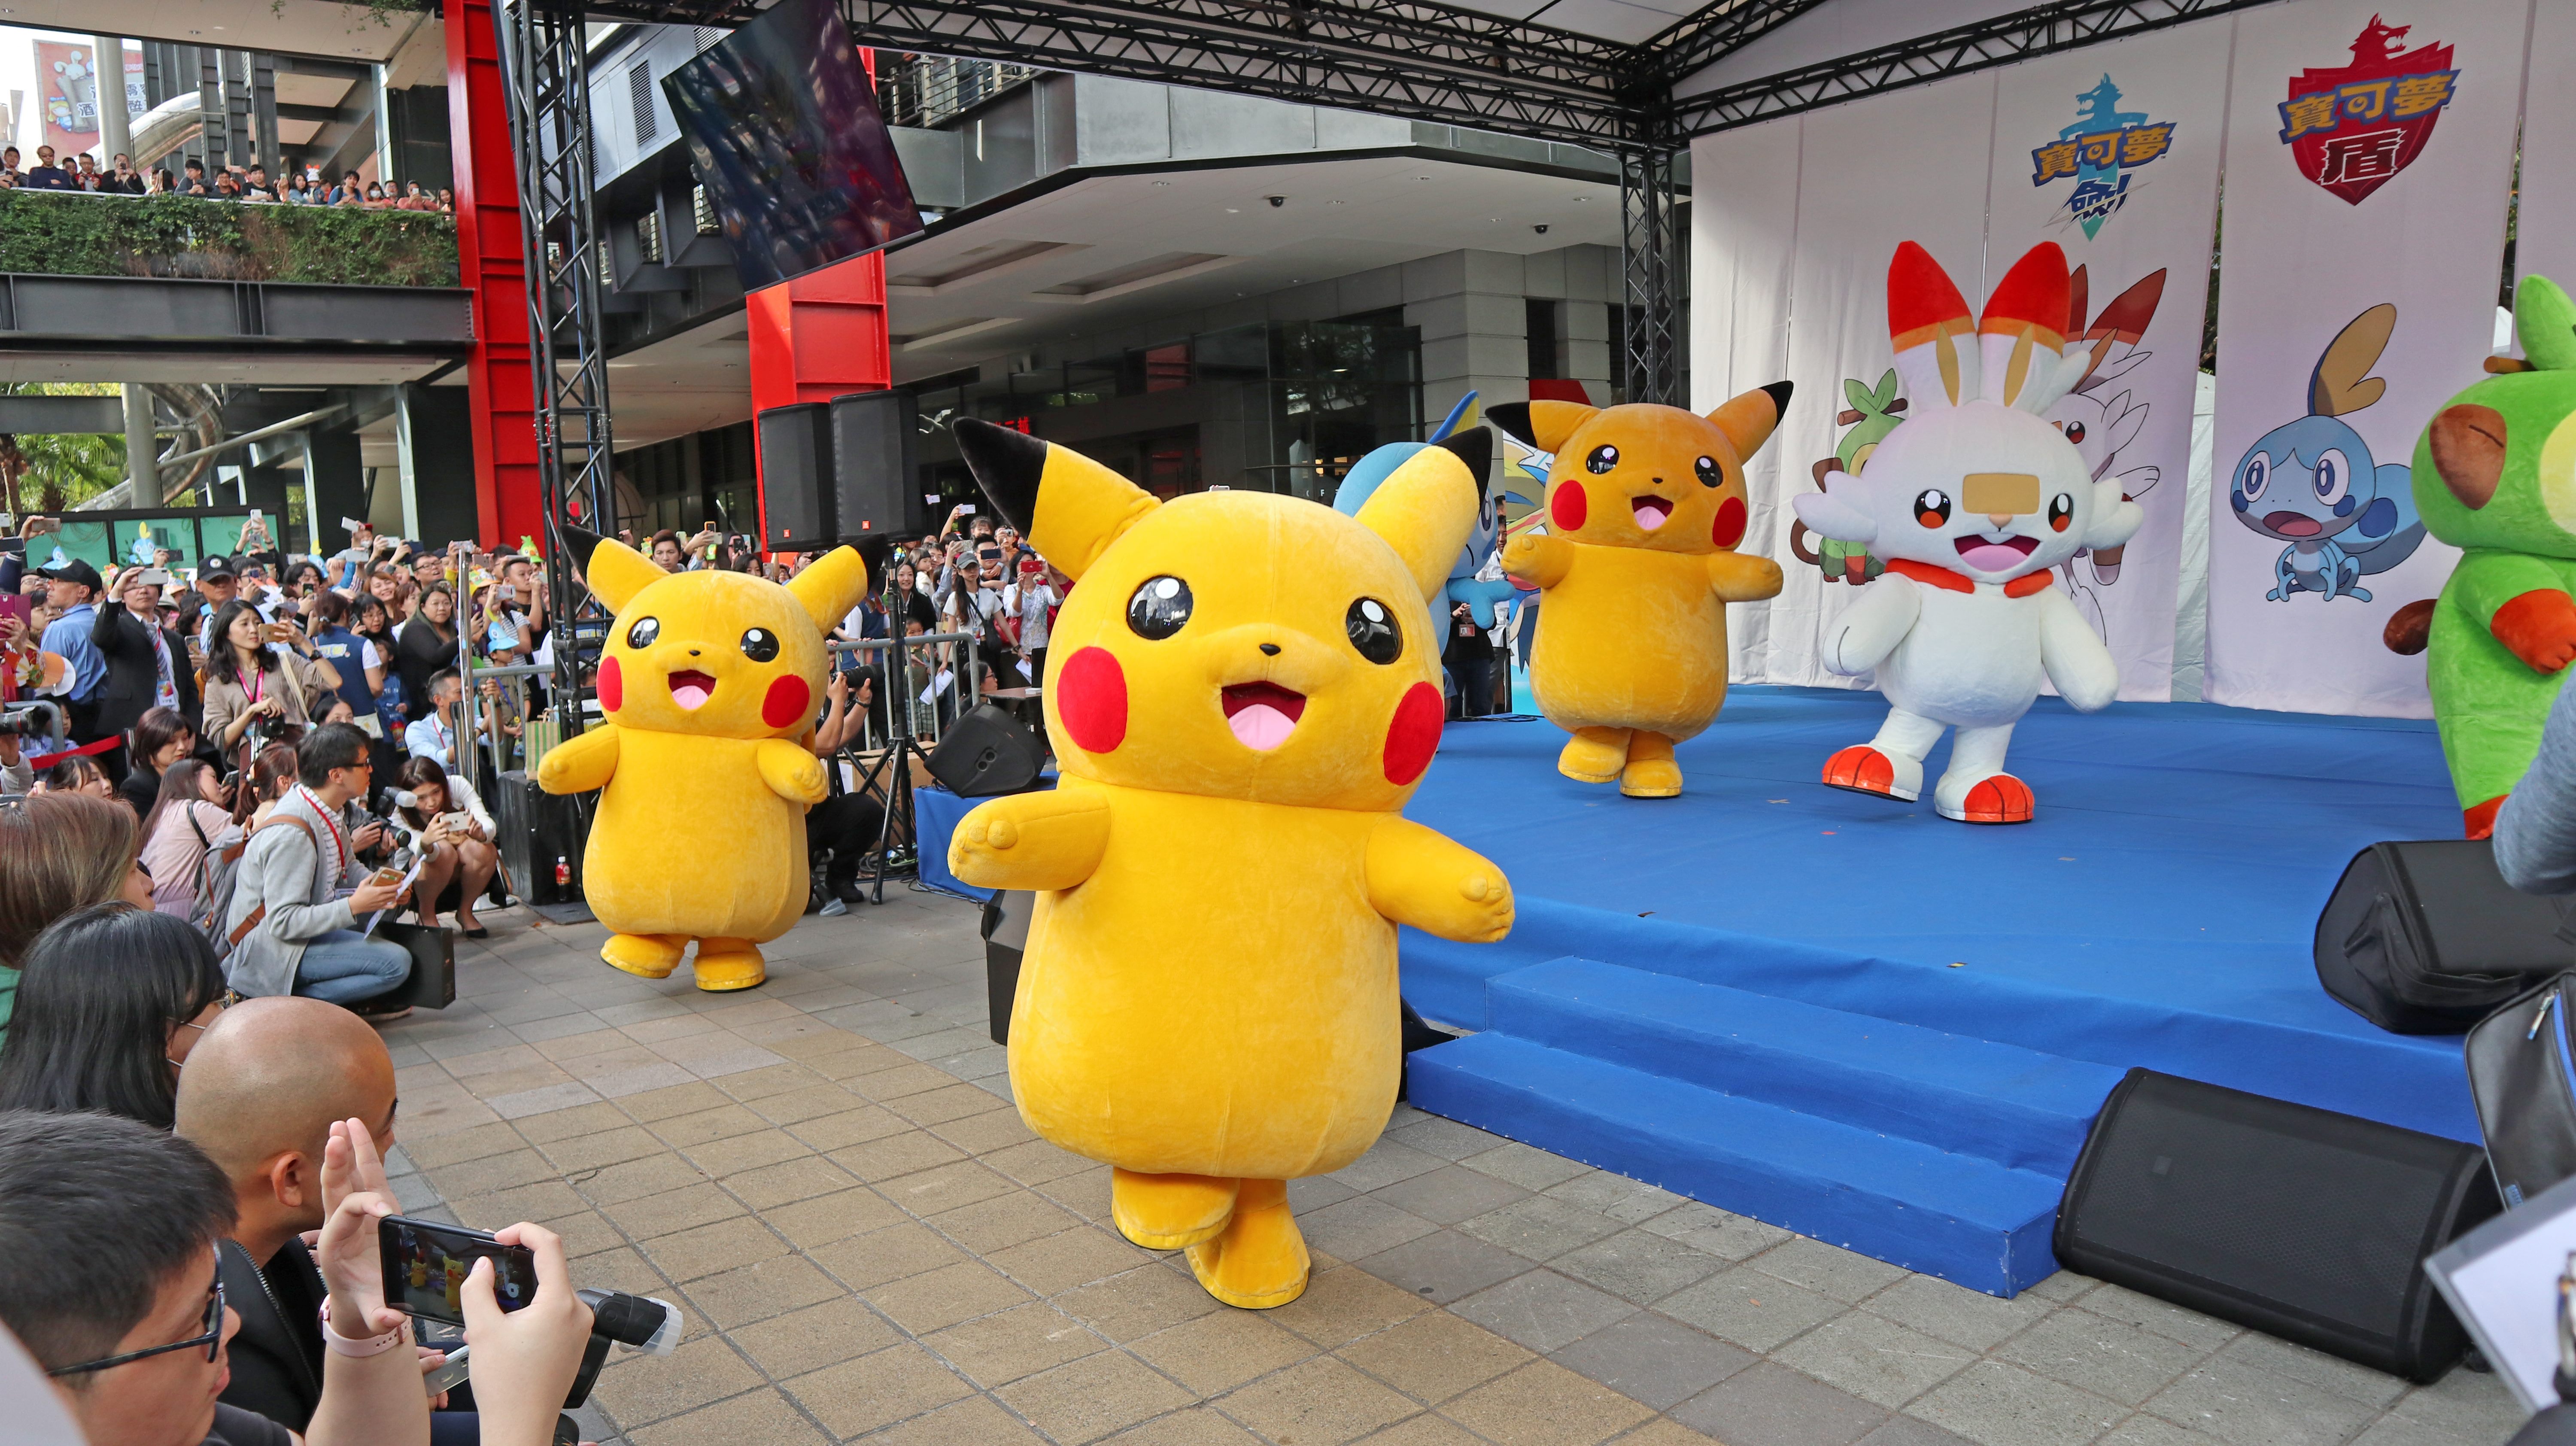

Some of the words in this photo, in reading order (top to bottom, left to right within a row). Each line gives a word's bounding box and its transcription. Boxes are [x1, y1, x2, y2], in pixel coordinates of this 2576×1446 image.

[2286, 75, 2453, 138] 寶可夢
[2038, 127, 2171, 181] 寶可夢
